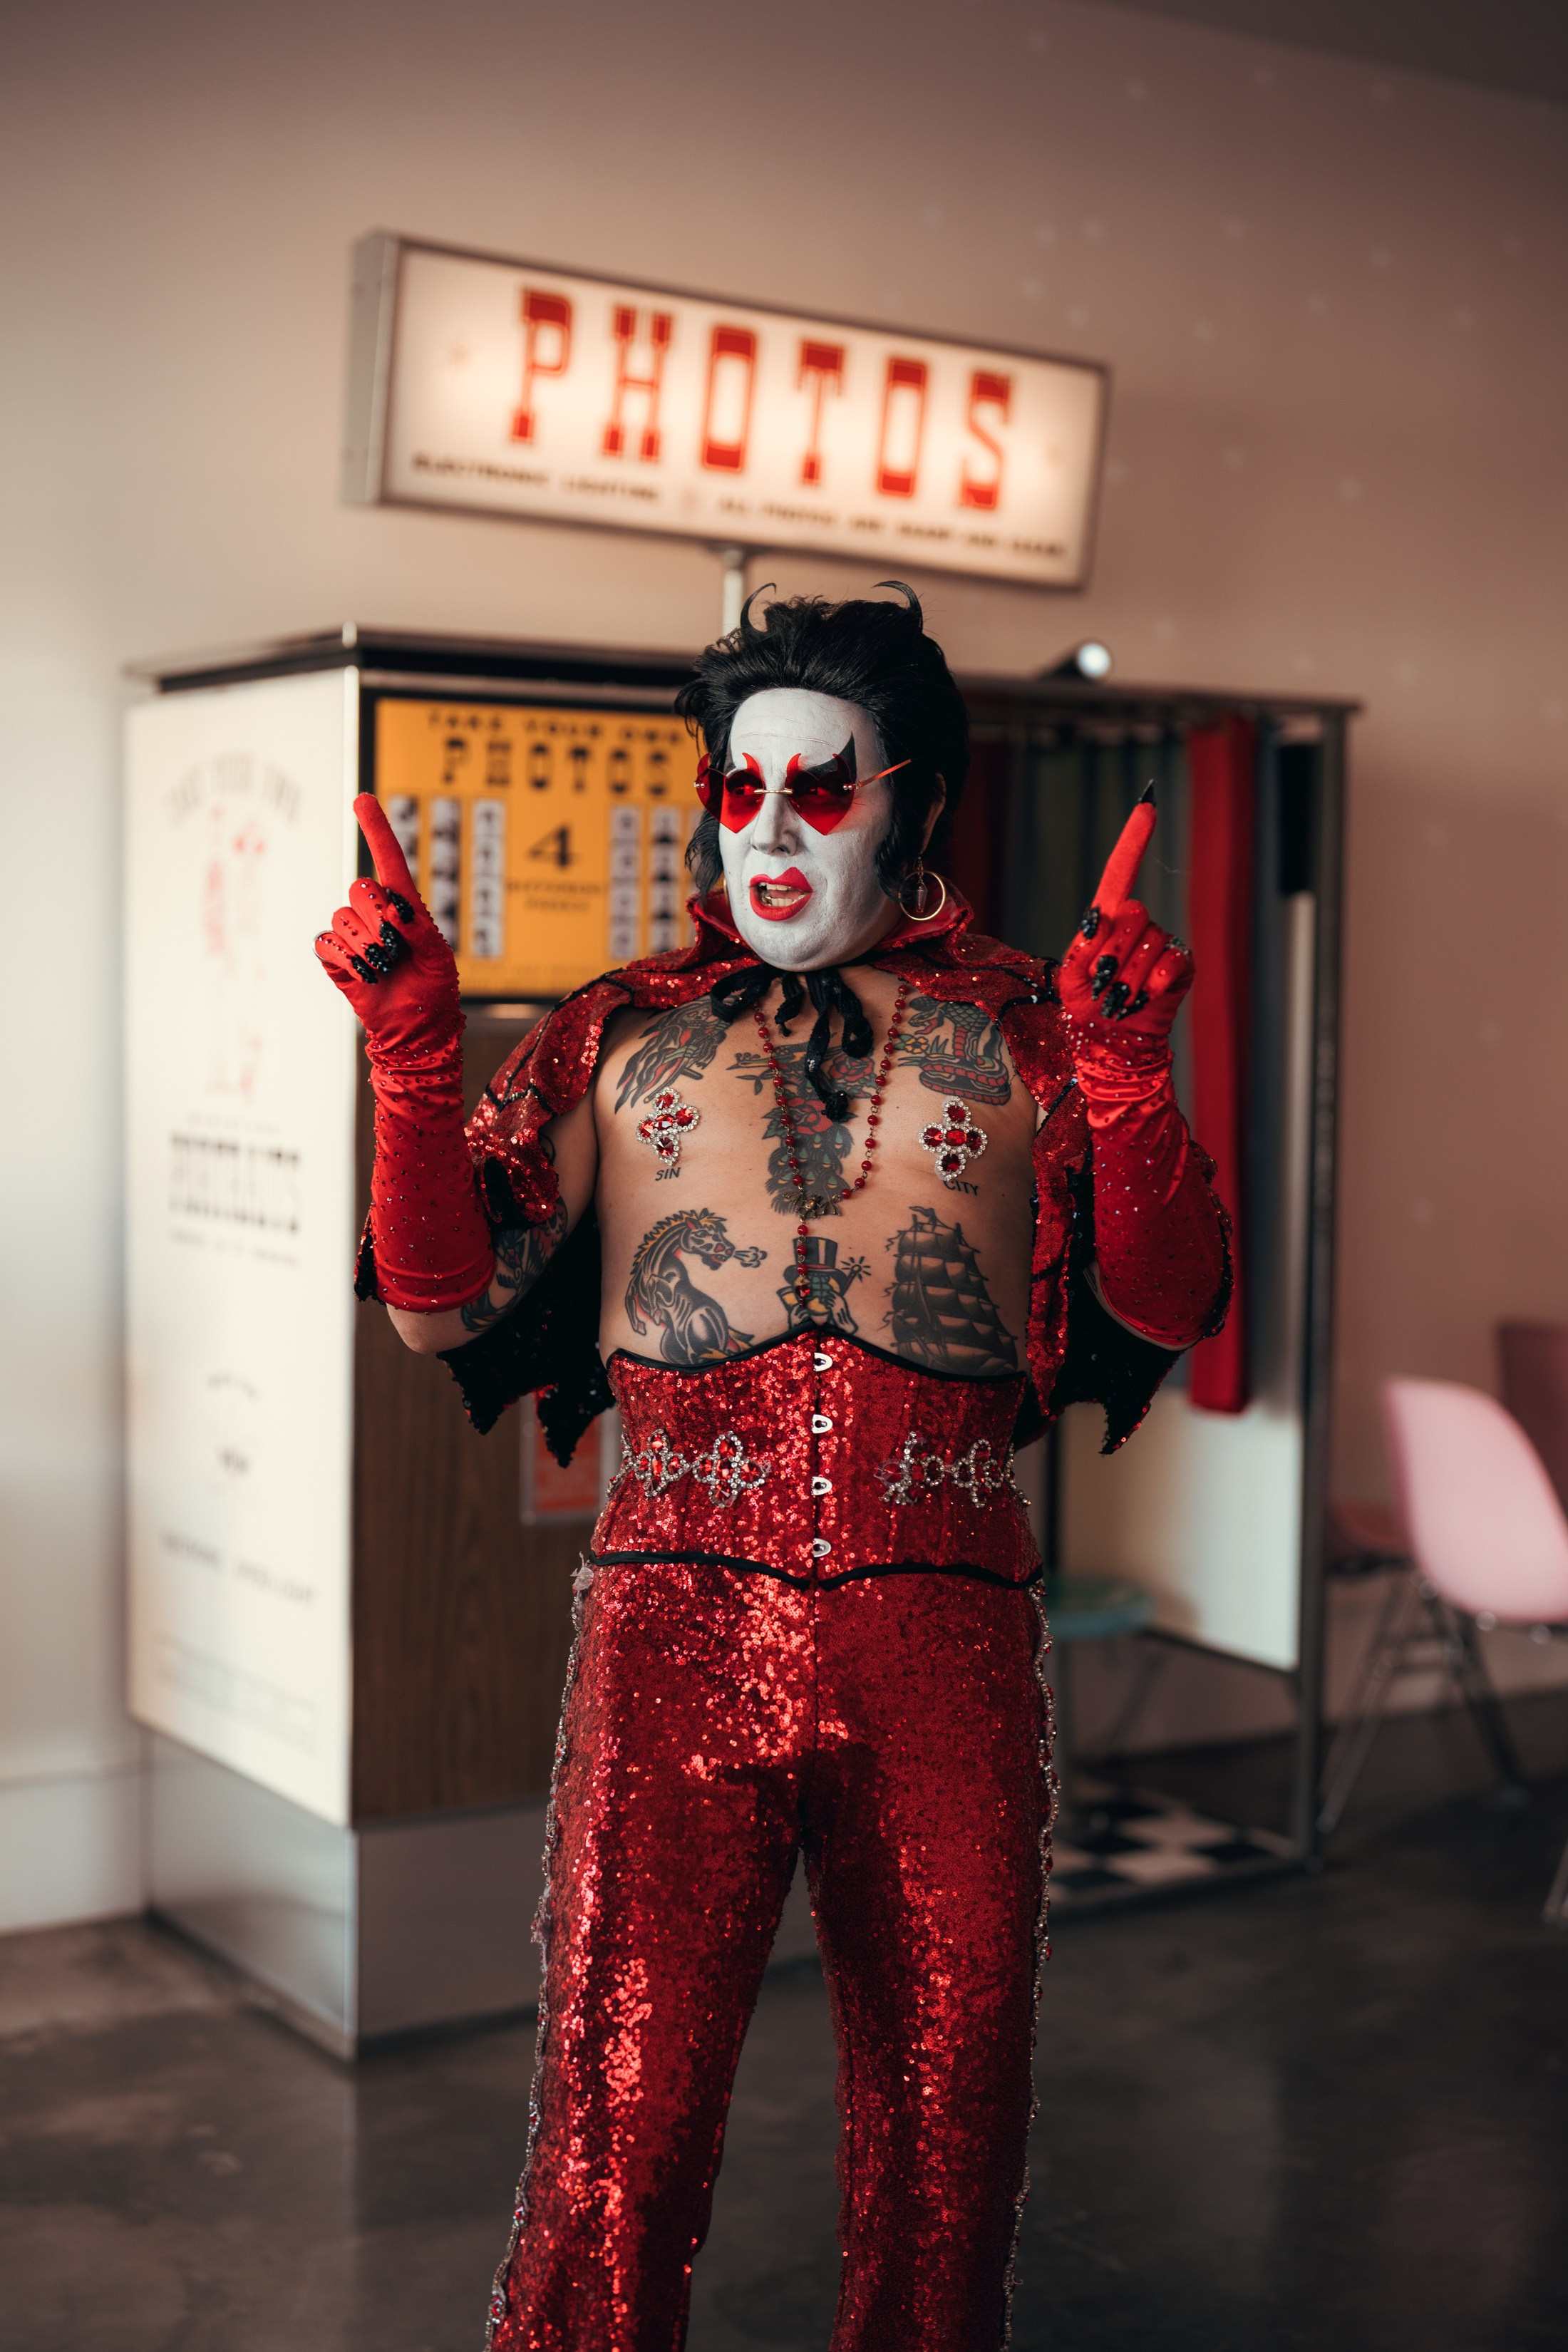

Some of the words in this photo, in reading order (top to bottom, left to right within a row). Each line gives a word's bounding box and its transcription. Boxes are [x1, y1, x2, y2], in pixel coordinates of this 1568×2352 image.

[510, 285, 1012, 511] PHOTOS
[441, 734, 668, 798] PHOTOS
[530, 822, 576, 869] 4
[654, 1167, 681, 1181] SIN
[943, 1180, 979, 1196] CITY
